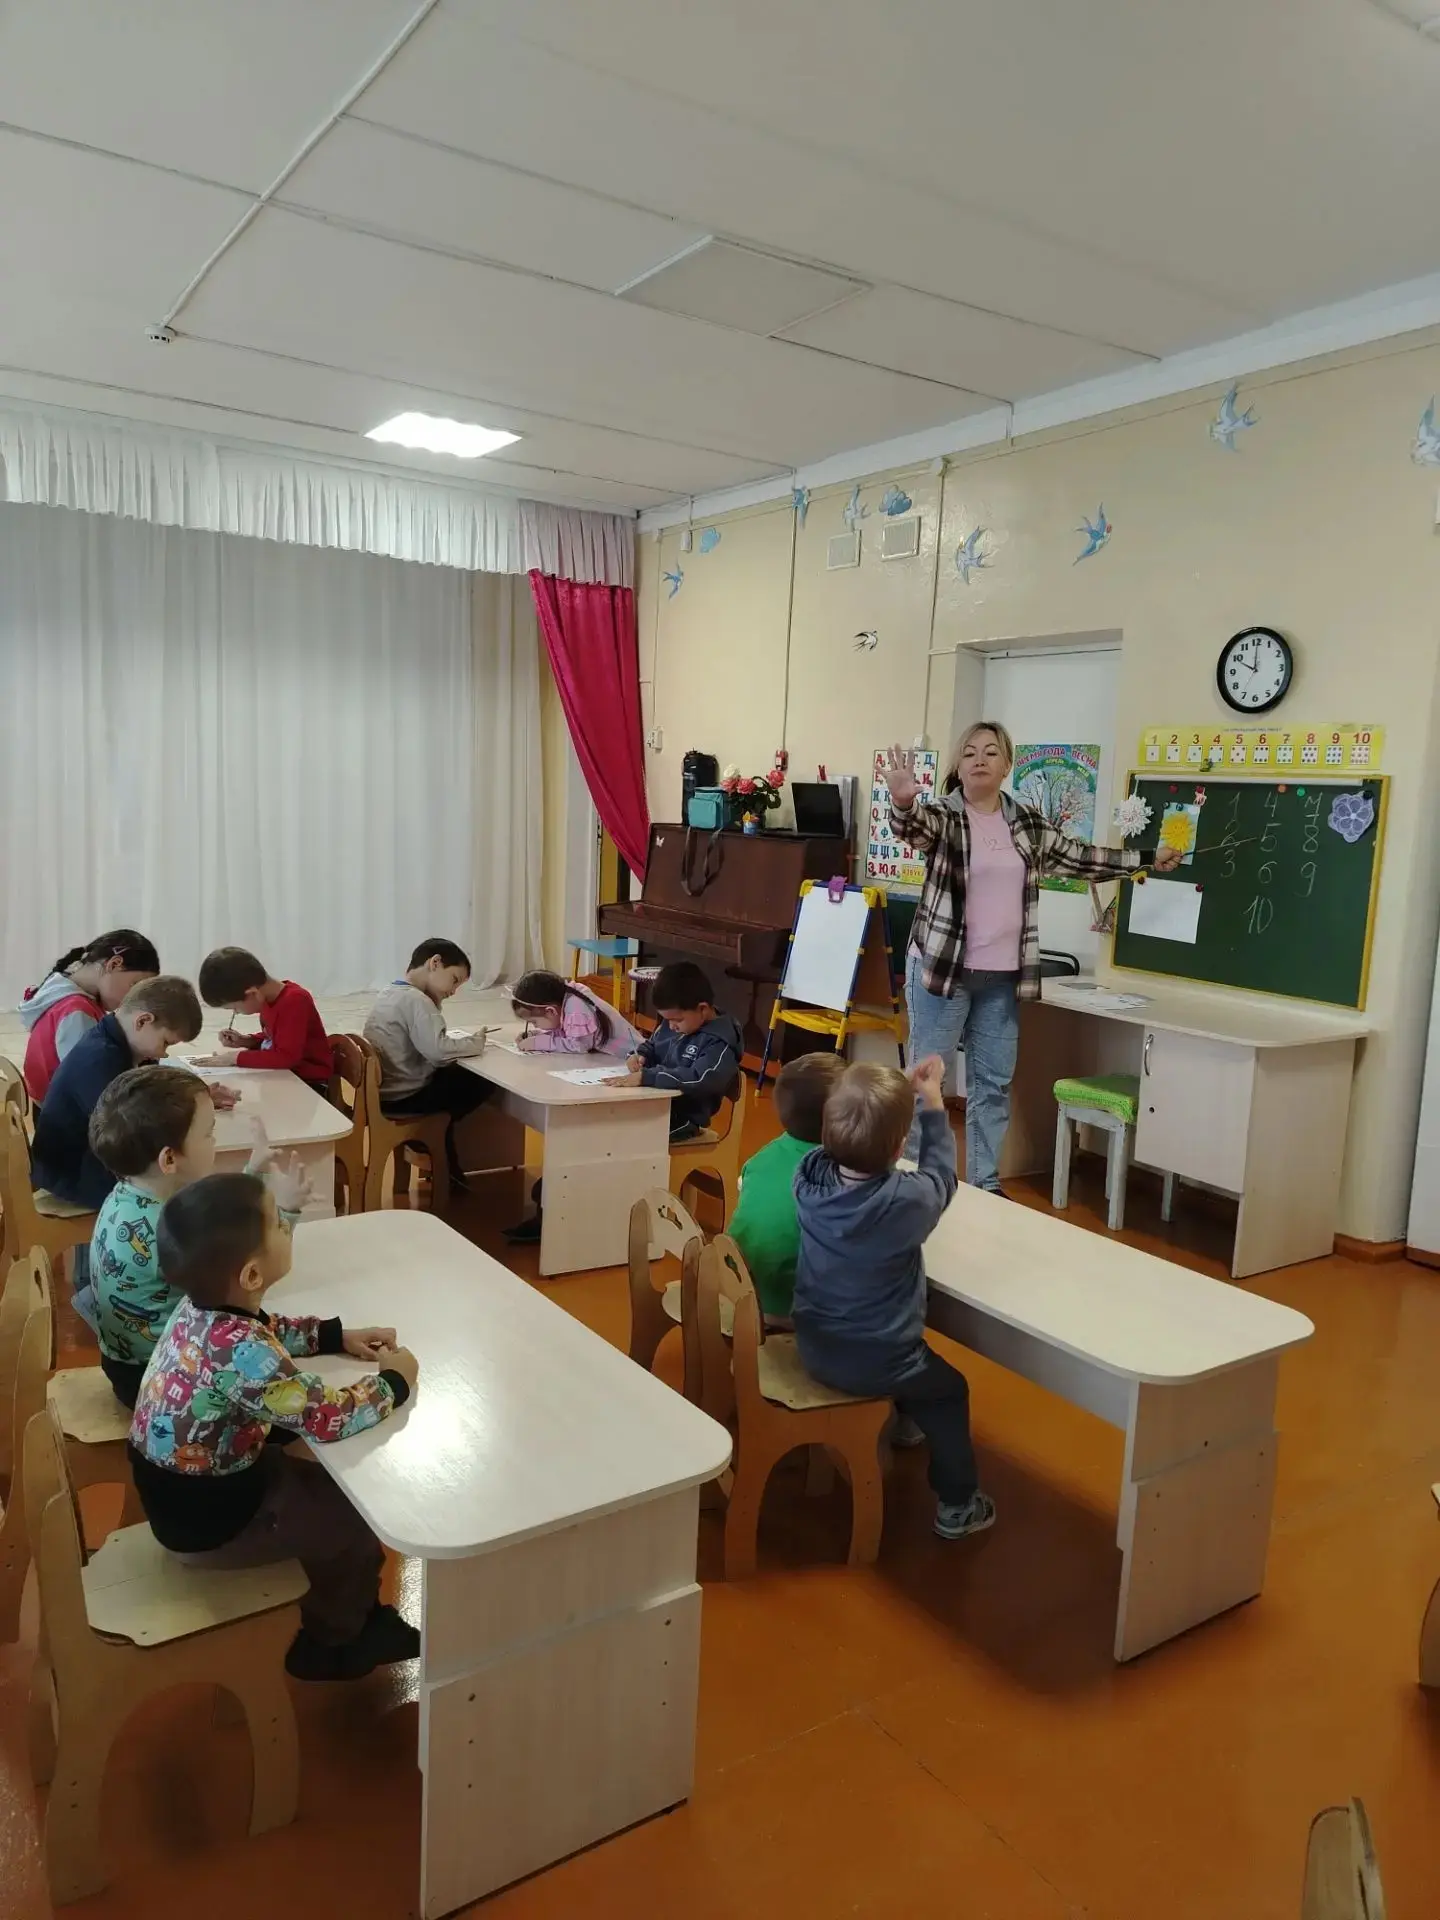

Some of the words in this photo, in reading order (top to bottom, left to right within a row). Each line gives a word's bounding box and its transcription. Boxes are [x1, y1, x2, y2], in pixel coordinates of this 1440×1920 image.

[1252, 638, 1262, 646] 12
[1267, 640, 1271, 648] 1
[1233, 654, 1243, 662] 10
[1275, 650, 1281, 658] 2
[1241, 692, 1247, 700] 7
[1252, 695, 1259, 703] 6
[1265, 690, 1271, 698] 5
[1150, 734, 1158, 744] 1
[1171, 734, 1178, 744] 2
[1193, 734, 1200, 744] 3
[1213, 734, 1221, 744] 4
[1236, 734, 1243, 744] 5
[1259, 733, 1267, 744] 6
[1282, 733, 1290, 744] 7
[1306, 733, 1315, 744] 8
[1332, 733, 1340, 744] 9
[1353, 733, 1371, 744] 10
[876, 754, 883, 764] А
[924, 754, 932, 765] Д
[1071, 750, 1097, 768] ВЕСНА
[921, 793, 929, 803] Н
[1229, 791, 1241, 818] 1
[1263, 791, 1279, 818] 4
[872, 807, 879, 819] О
[871, 825, 877, 837] У
[880, 827, 889, 838] Ф
[1259, 822, 1281, 853] 5
[1302, 824, 1319, 853] 8
[869, 844, 878, 855] Ш
[880, 844, 890, 859] Щ
[892, 846, 900, 858] Ъ
[903, 848, 914, 859] Ы
[868, 861, 875, 873] Э
[878, 862, 889, 874] Ю
[890, 865, 897, 875] Я
[1219, 849, 1236, 878] 3
[1257, 860, 1278, 884] 6
[1295, 861, 1318, 898] 9
[1242, 895, 1274, 934] 10
[258, 1357, 276, 1374] m
[168, 1384, 183, 1400] m
[204, 1410, 220, 1420] m
[327, 1416, 341, 1431] m
